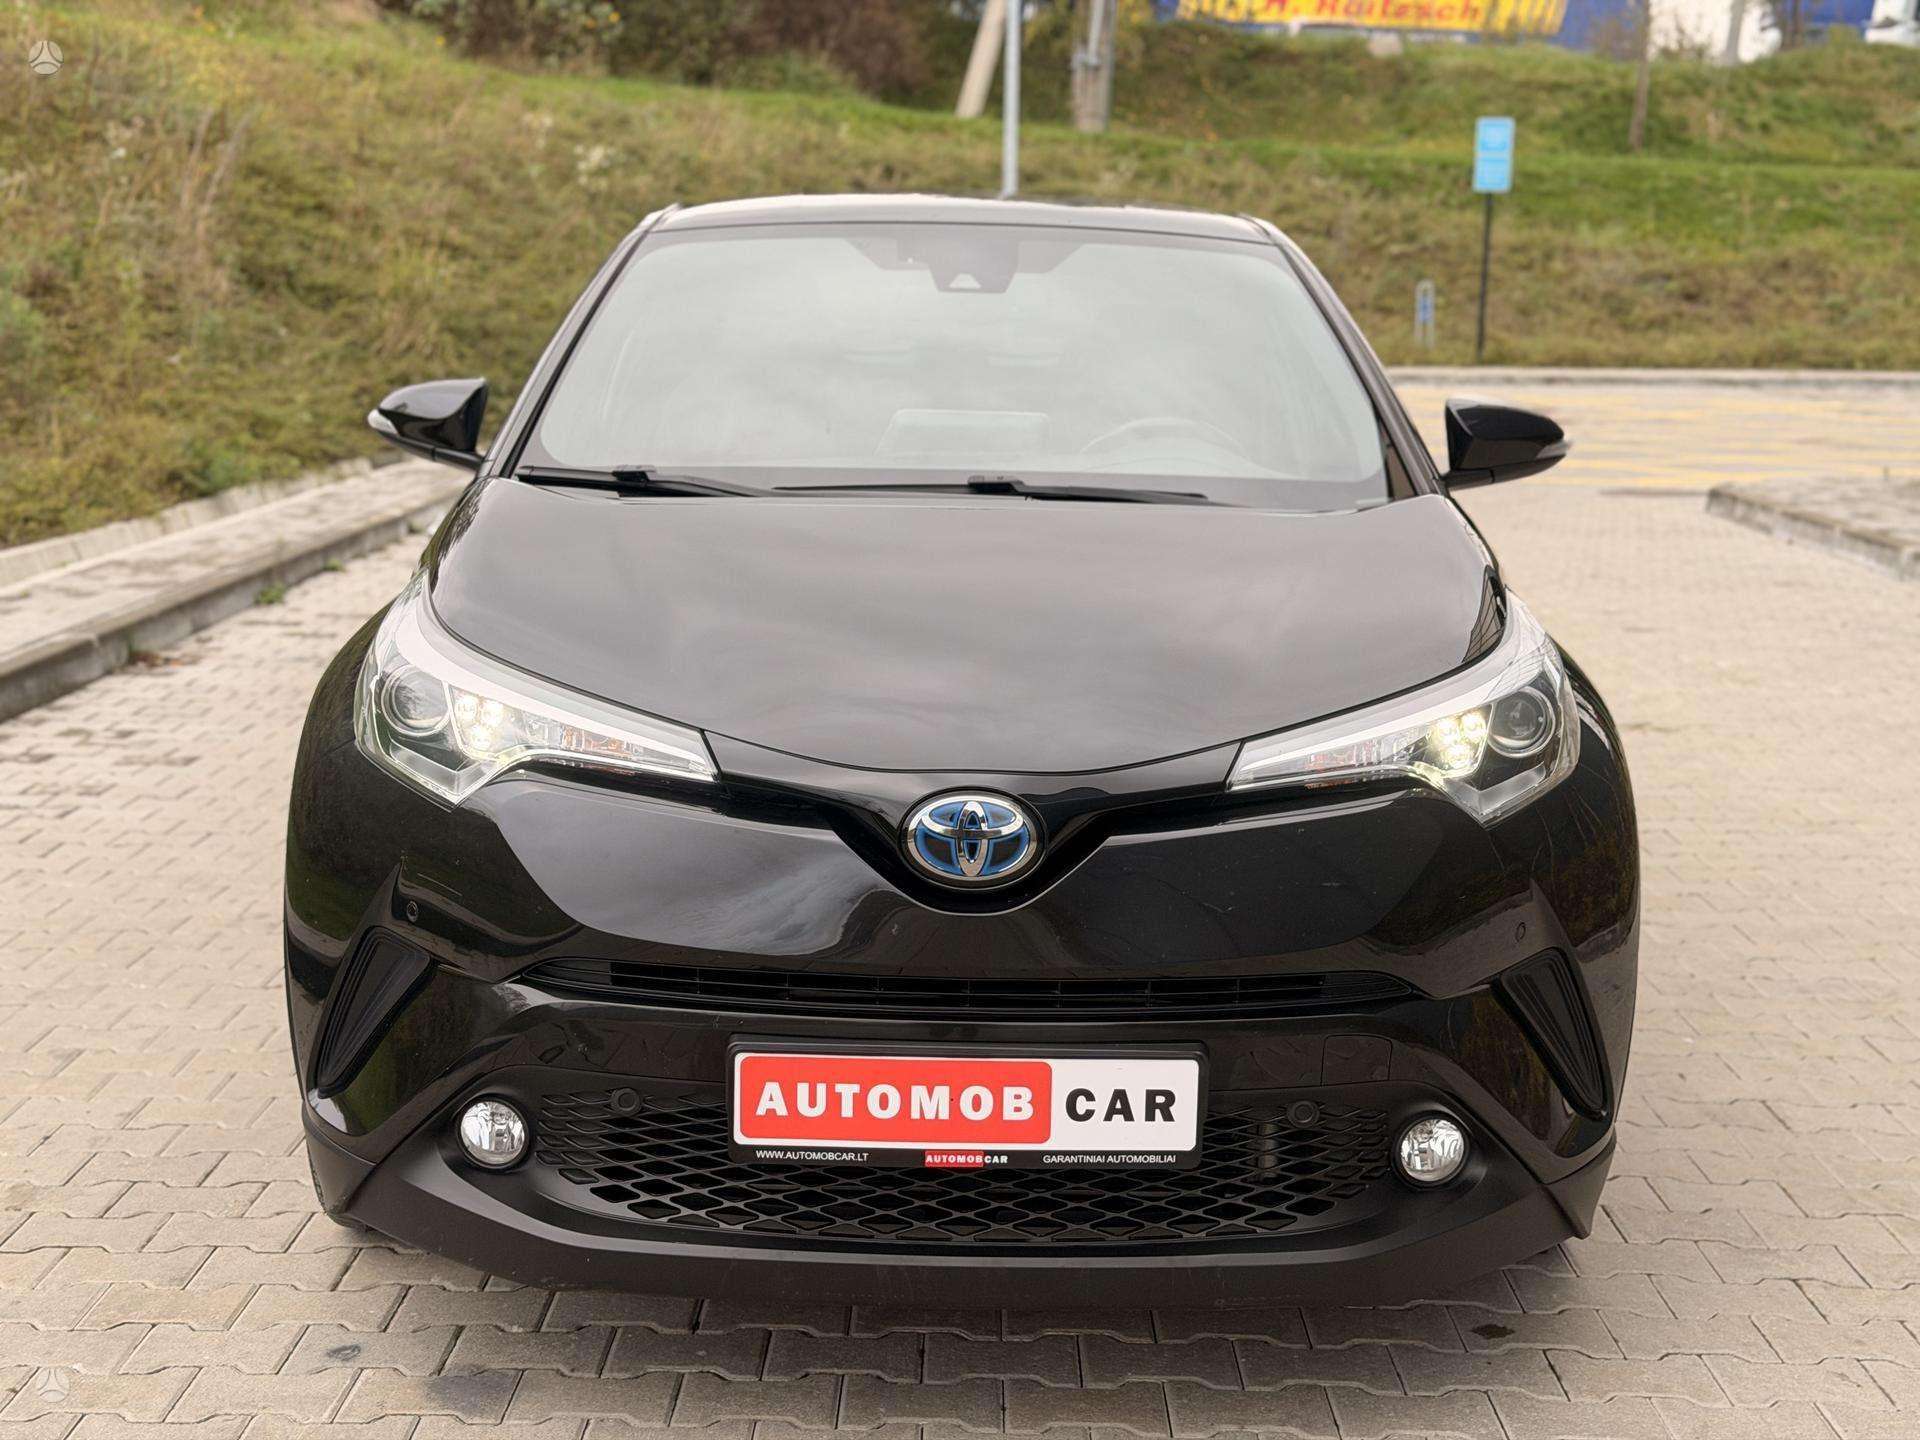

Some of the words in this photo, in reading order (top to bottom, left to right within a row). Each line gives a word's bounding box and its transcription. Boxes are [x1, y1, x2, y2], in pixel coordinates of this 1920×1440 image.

[755, 1081, 1034, 1121] AUTOMOB
[1064, 1087, 1177, 1123] CAR
[755, 1150, 869, 1162] WWW.AUTOMOBCAR.LT
[1042, 1154, 1105, 1164] GARANTINIAI
[1106, 1154, 1176, 1164] AUTOMOBILIAI
